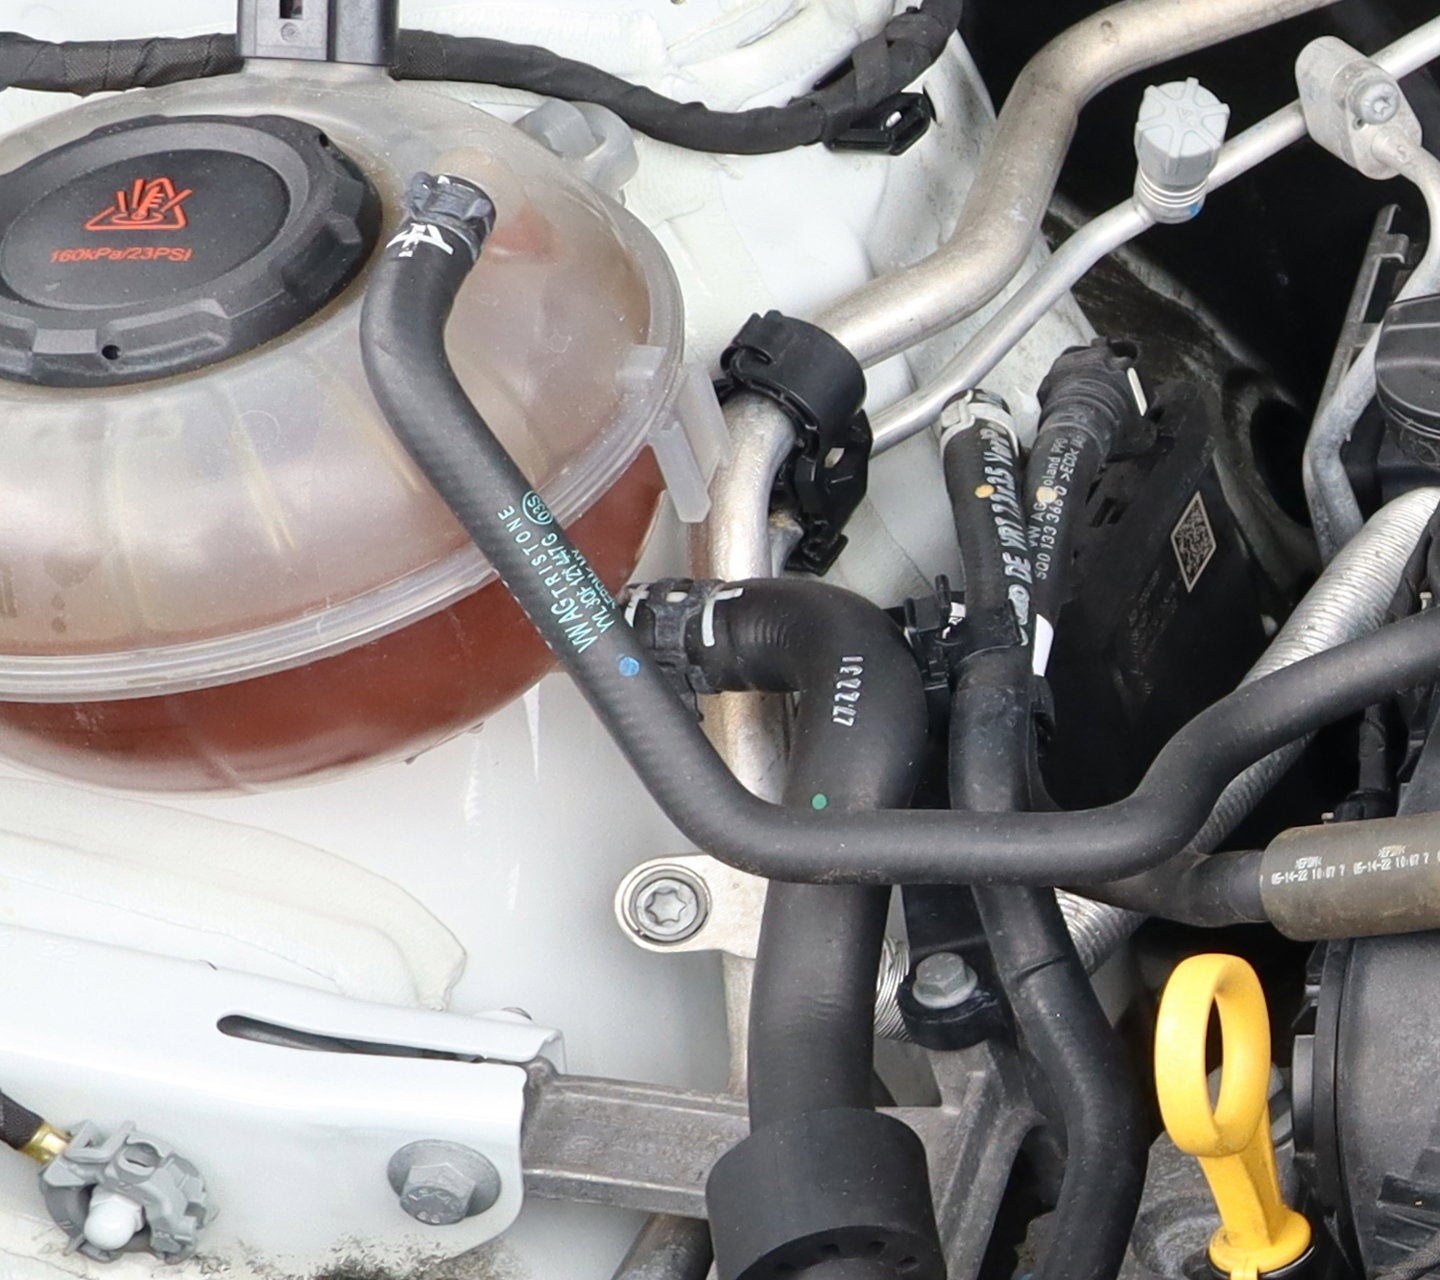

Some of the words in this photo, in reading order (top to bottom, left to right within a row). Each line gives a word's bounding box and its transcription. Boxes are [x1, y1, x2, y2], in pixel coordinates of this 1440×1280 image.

[49, 246, 194, 262] 160kPa/23PSI
[541, 533, 558, 545] G
[1040, 524, 1058, 549] 133
[498, 505, 565, 599] TRISTONE
[563, 564, 587, 586] 121
[1003, 551, 1033, 583] DE
[551, 598, 578, 625] AG
[564, 624, 598, 653] VW
